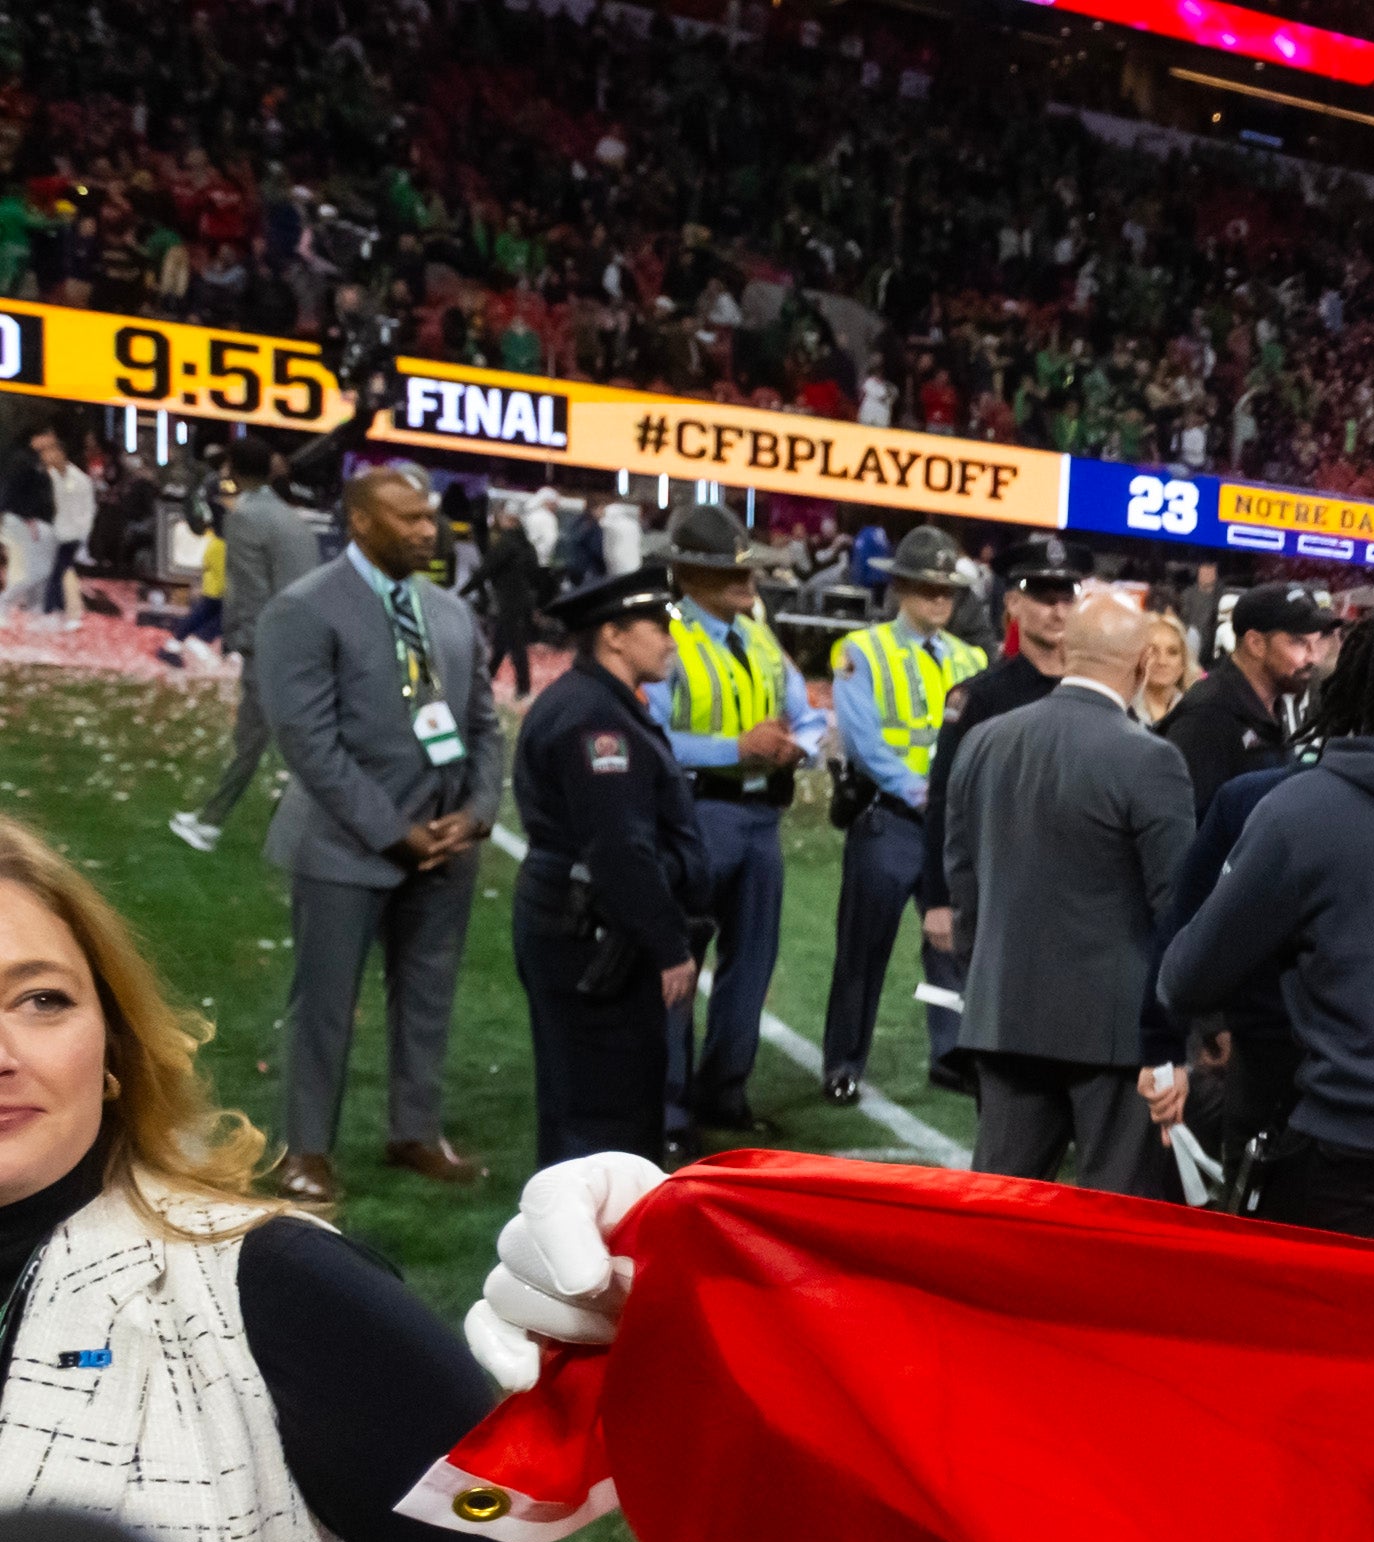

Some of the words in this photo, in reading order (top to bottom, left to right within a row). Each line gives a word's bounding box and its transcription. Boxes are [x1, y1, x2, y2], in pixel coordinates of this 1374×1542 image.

[114, 325, 324, 421] 9:55
[406, 376, 568, 447] FINAL
[635, 413, 1018, 501] #CFBPLAYOFF
[1127, 475, 1199, 535] 23
[1234, 494, 1327, 527] NOTRE
